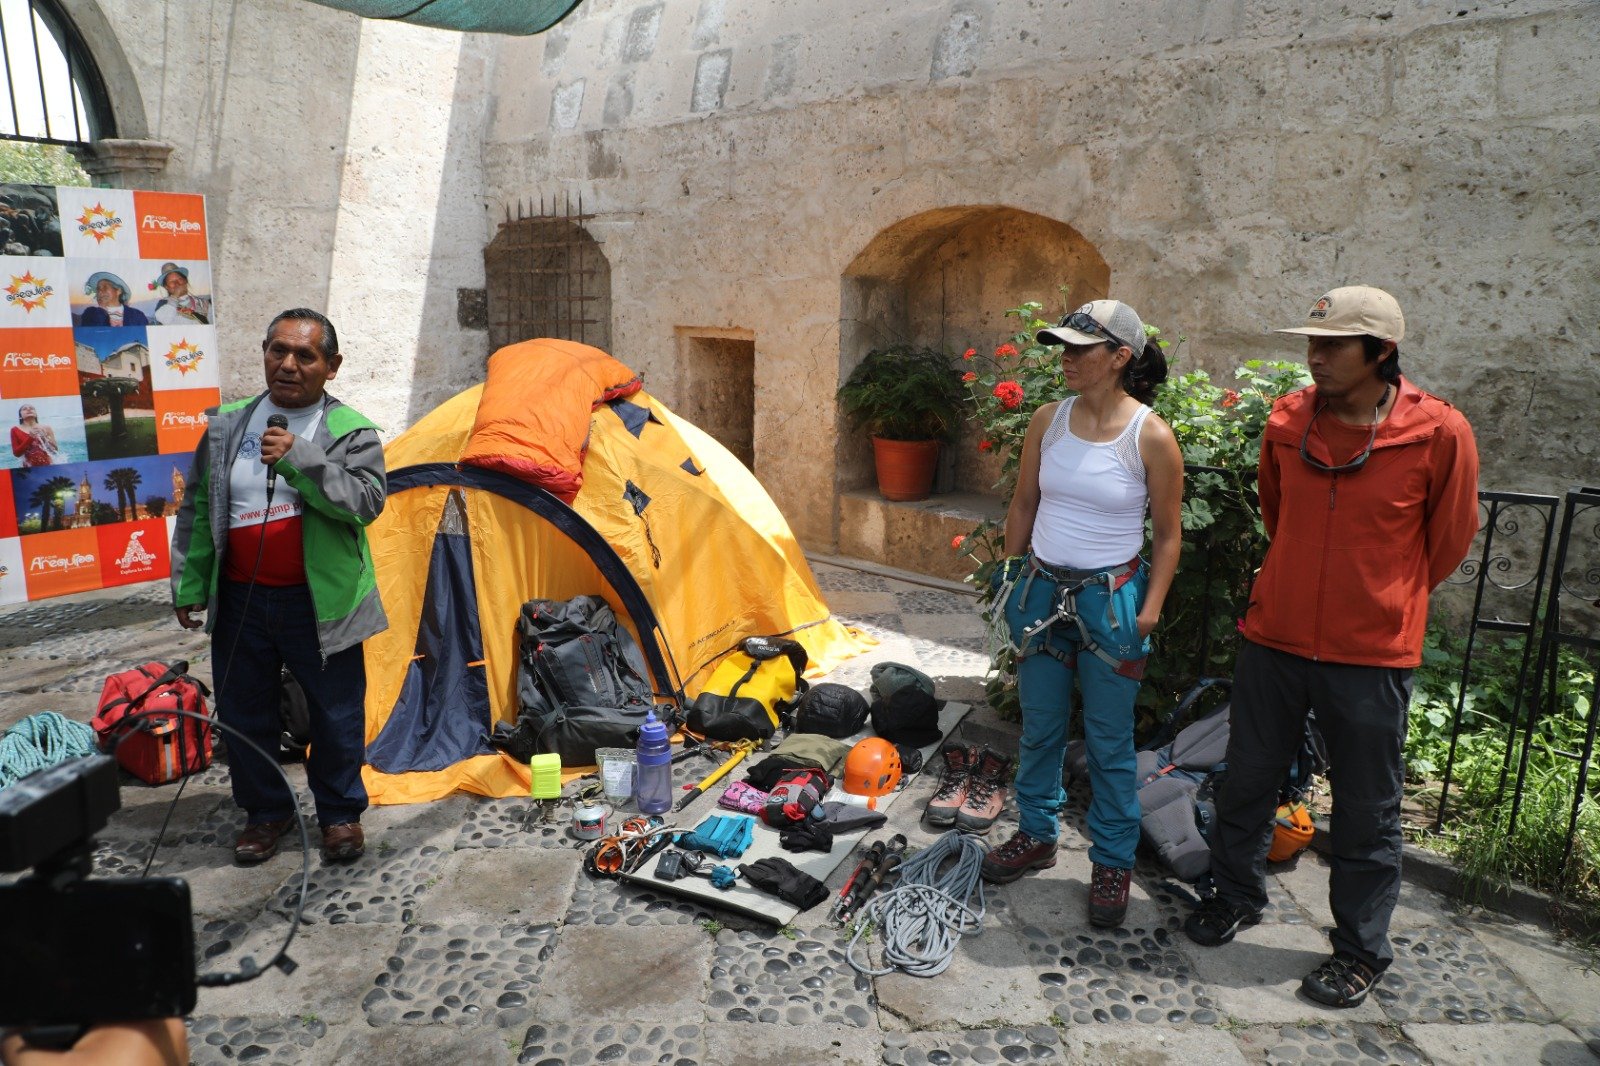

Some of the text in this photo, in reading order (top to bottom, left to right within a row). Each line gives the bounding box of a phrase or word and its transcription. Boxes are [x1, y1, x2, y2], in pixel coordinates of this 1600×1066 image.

[142, 214, 201, 232] Arequipa
[3, 352, 71, 369] Arequipa
[162, 412, 208, 429] Arequip
[30, 553, 95, 572] Arequipa
[115, 553, 157, 565] AREQUIPA
